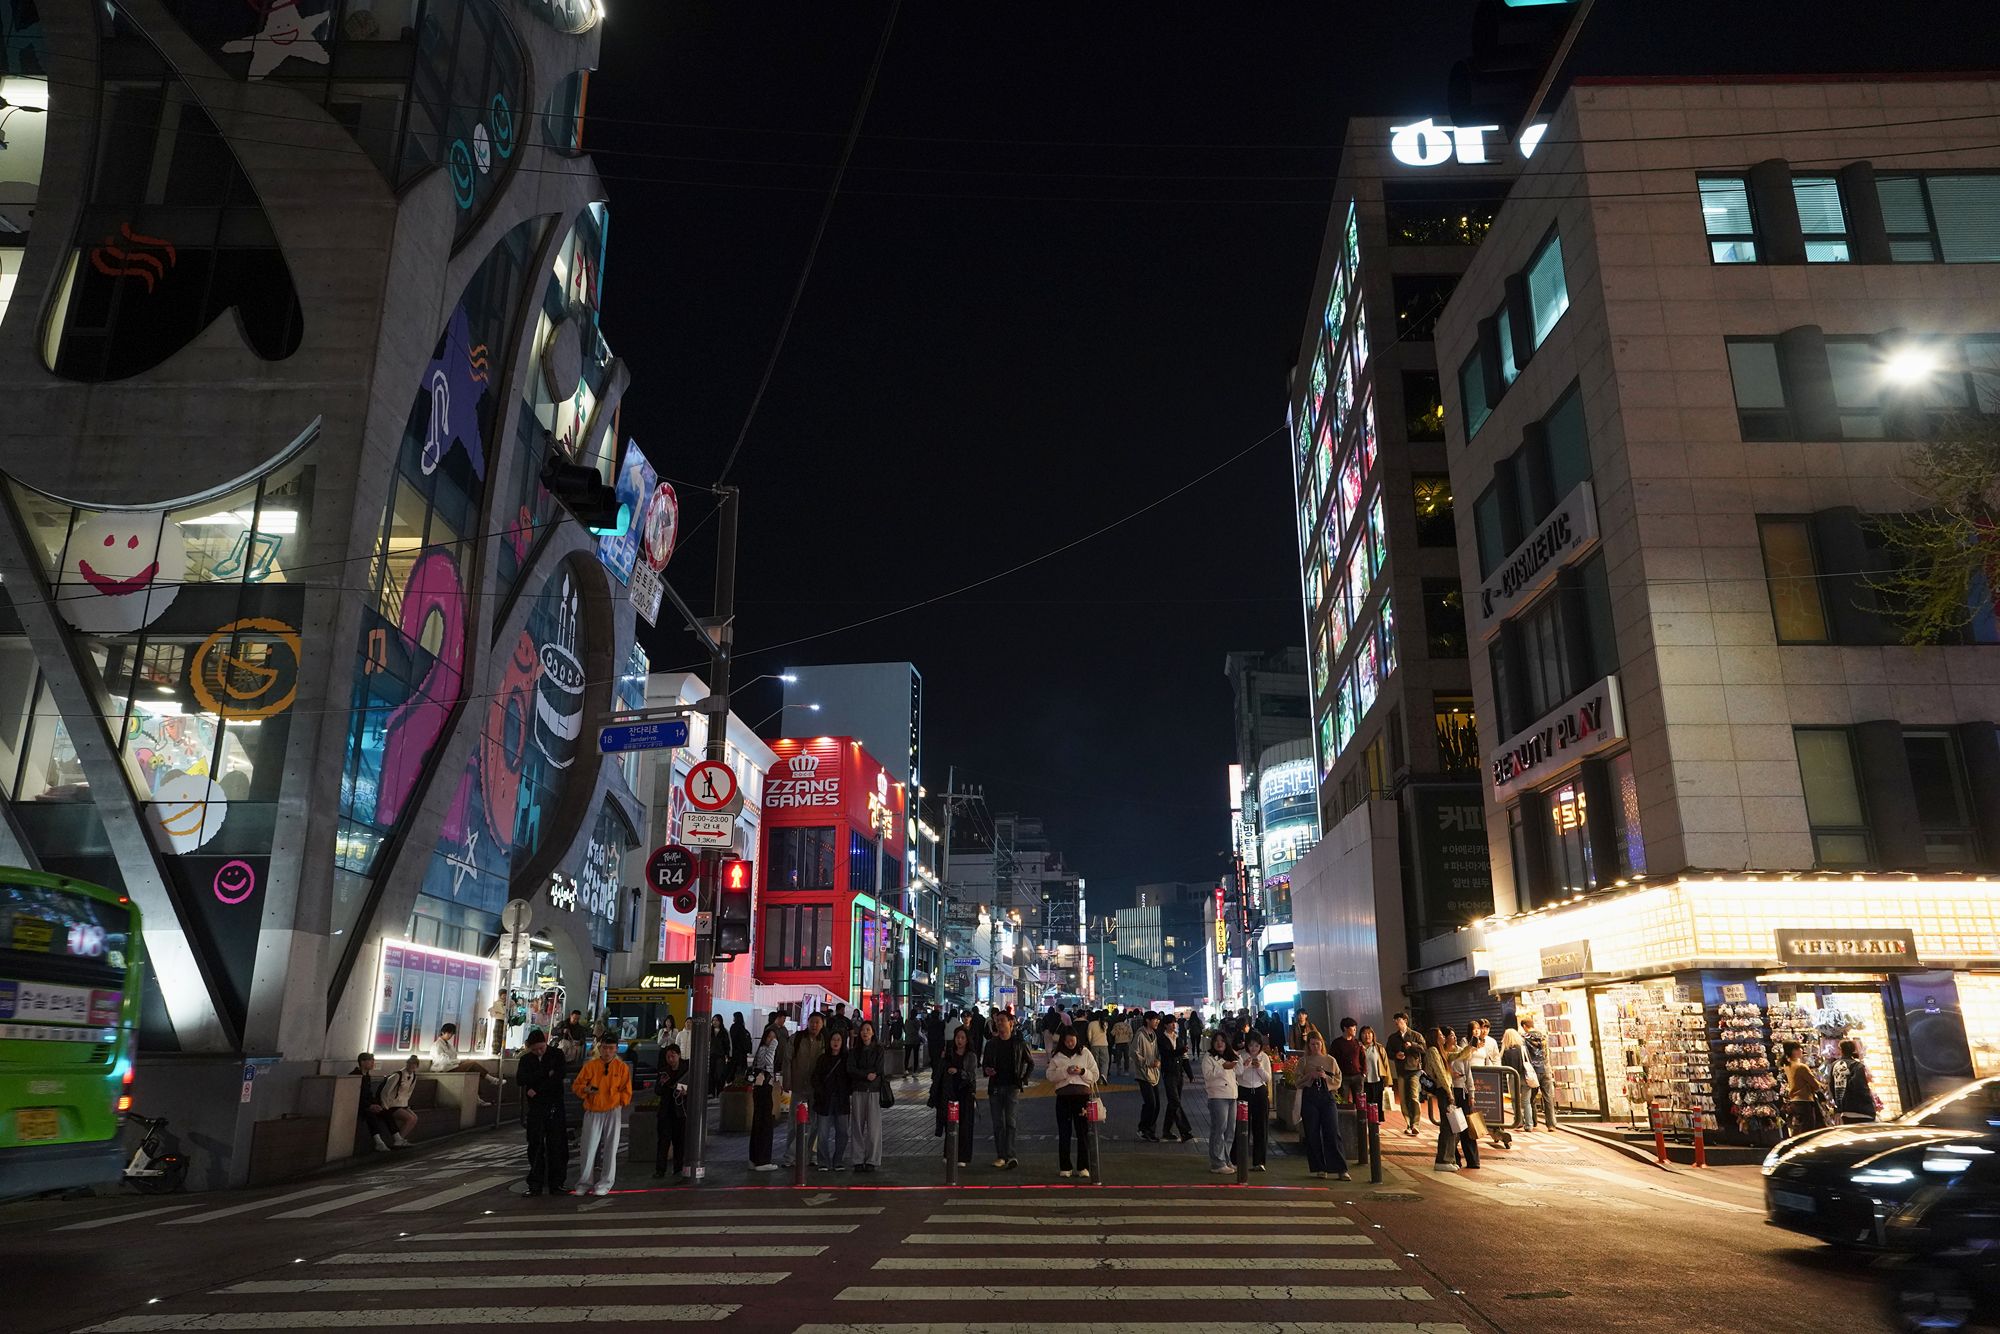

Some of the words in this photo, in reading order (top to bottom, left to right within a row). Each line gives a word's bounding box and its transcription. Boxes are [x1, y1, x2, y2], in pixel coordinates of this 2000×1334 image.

[603, 736, 613, 744] 18
[675, 729, 685, 737] 14
[1493, 727, 1553, 787] BEAUTY
[1556, 697, 1602, 750] PLAY
[765, 778, 840, 794] ZZANG
[765, 793, 840, 808] GAMES
[659, 868, 684, 885] R4
